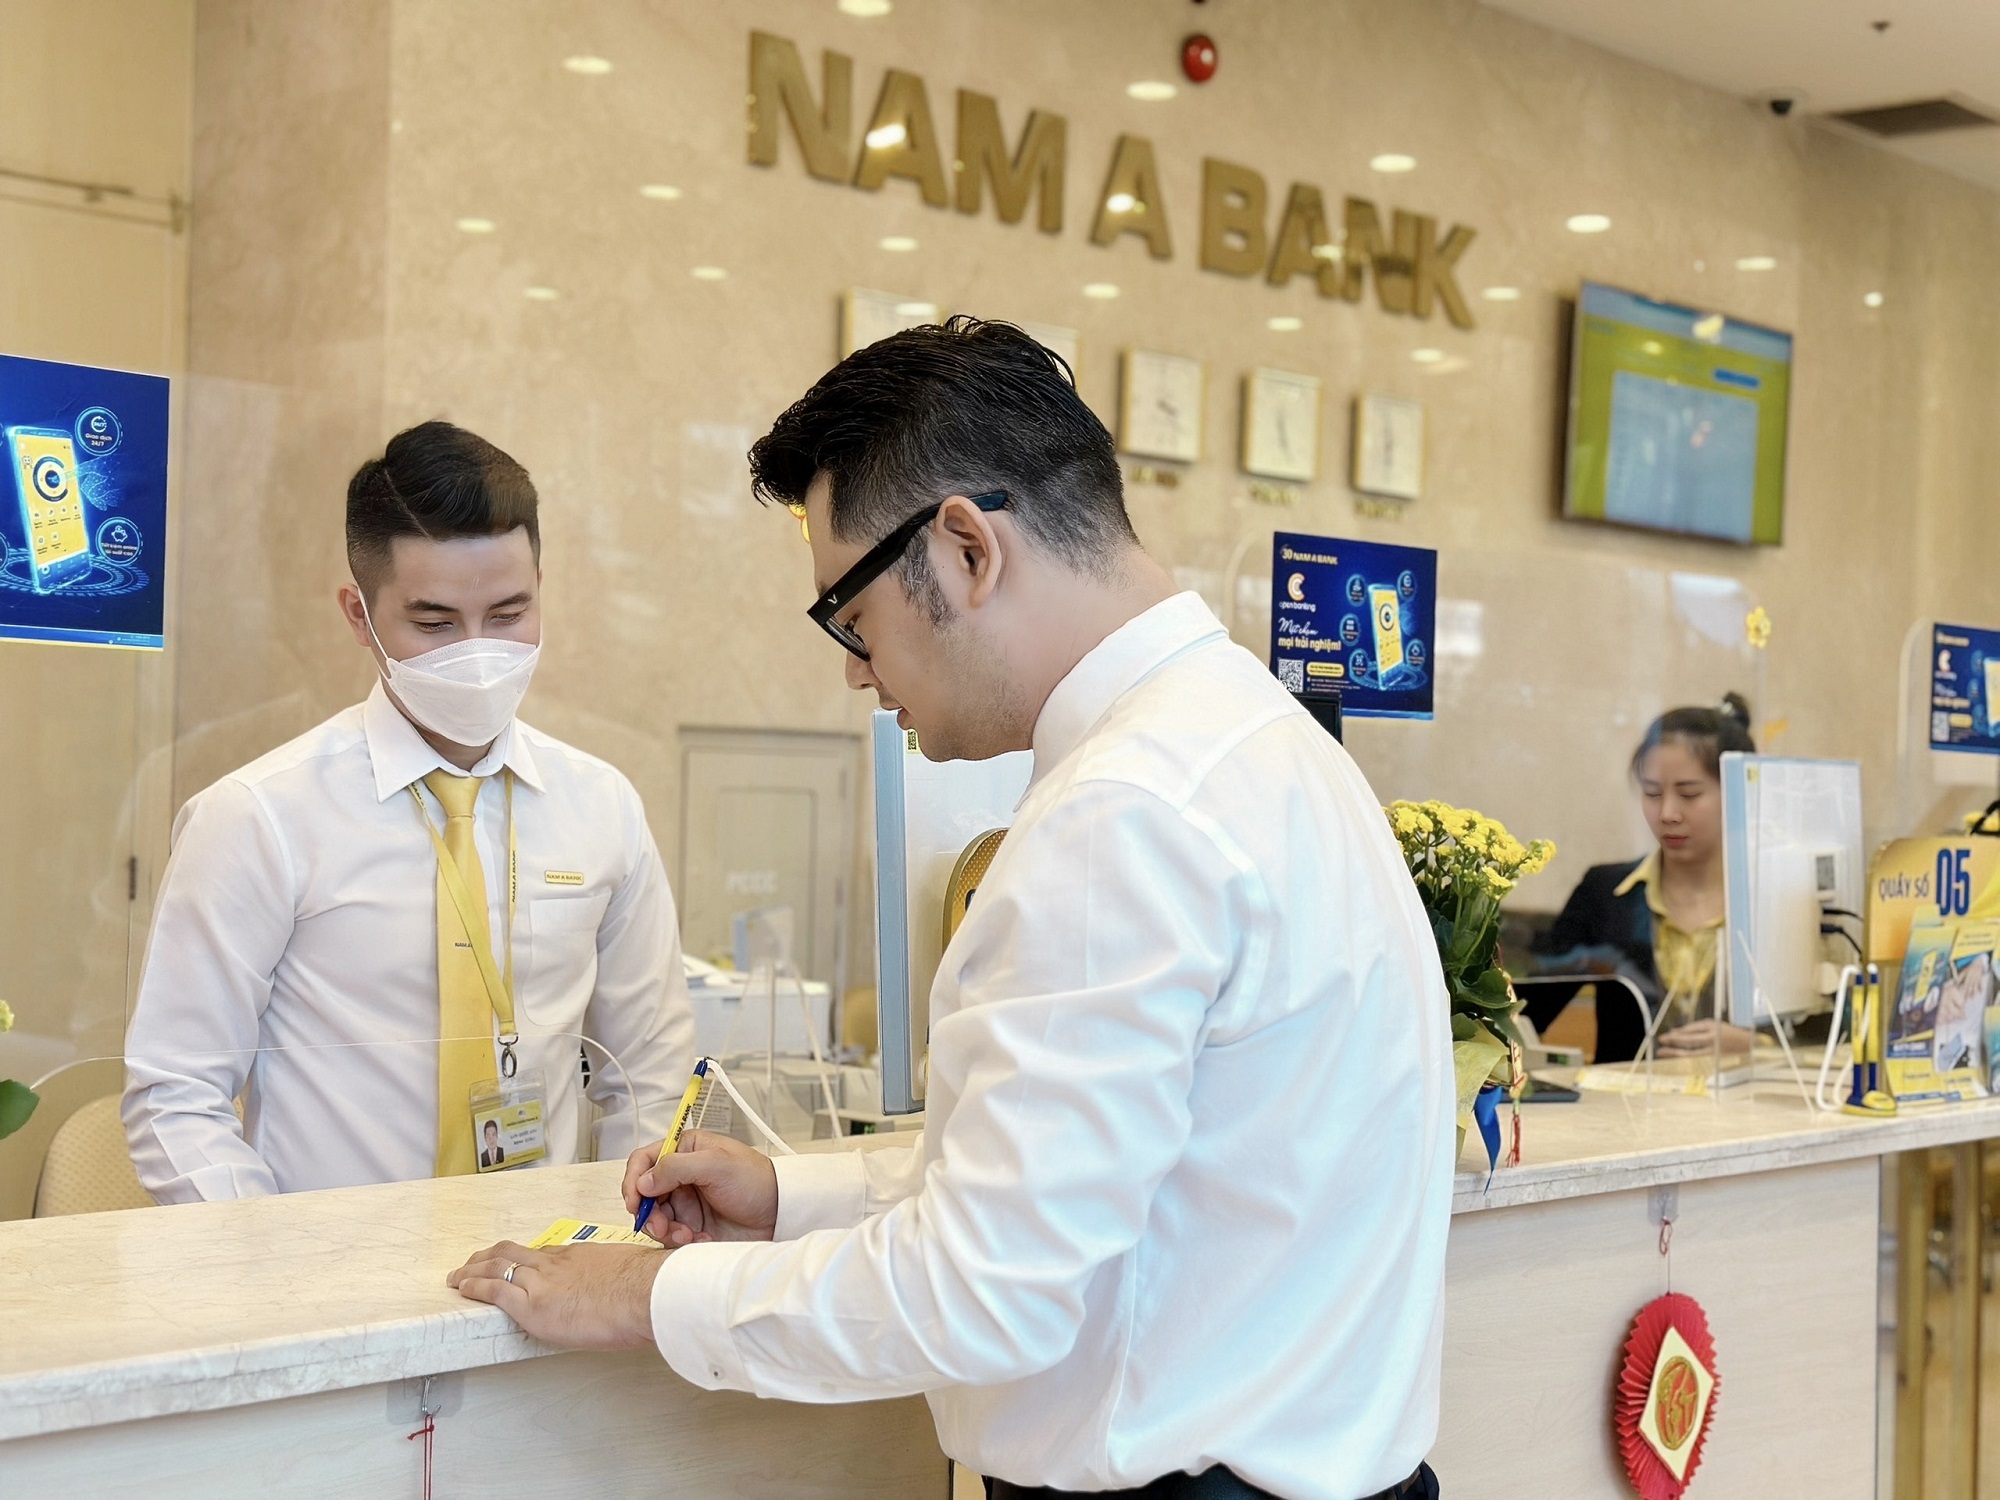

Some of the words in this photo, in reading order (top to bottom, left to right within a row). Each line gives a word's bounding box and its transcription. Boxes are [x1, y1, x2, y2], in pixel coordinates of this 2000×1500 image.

[747, 27, 1068, 236] NAM
[1089, 132, 1173, 261] A
[1198, 155, 1477, 331] BANK
[1293, 552, 1312, 562] NAM
[1311, 554, 1317, 563] A
[1317, 554, 1338, 565] BANK
[1278, 636, 1294, 650] mọi
[1936, 848, 1971, 917] 05
